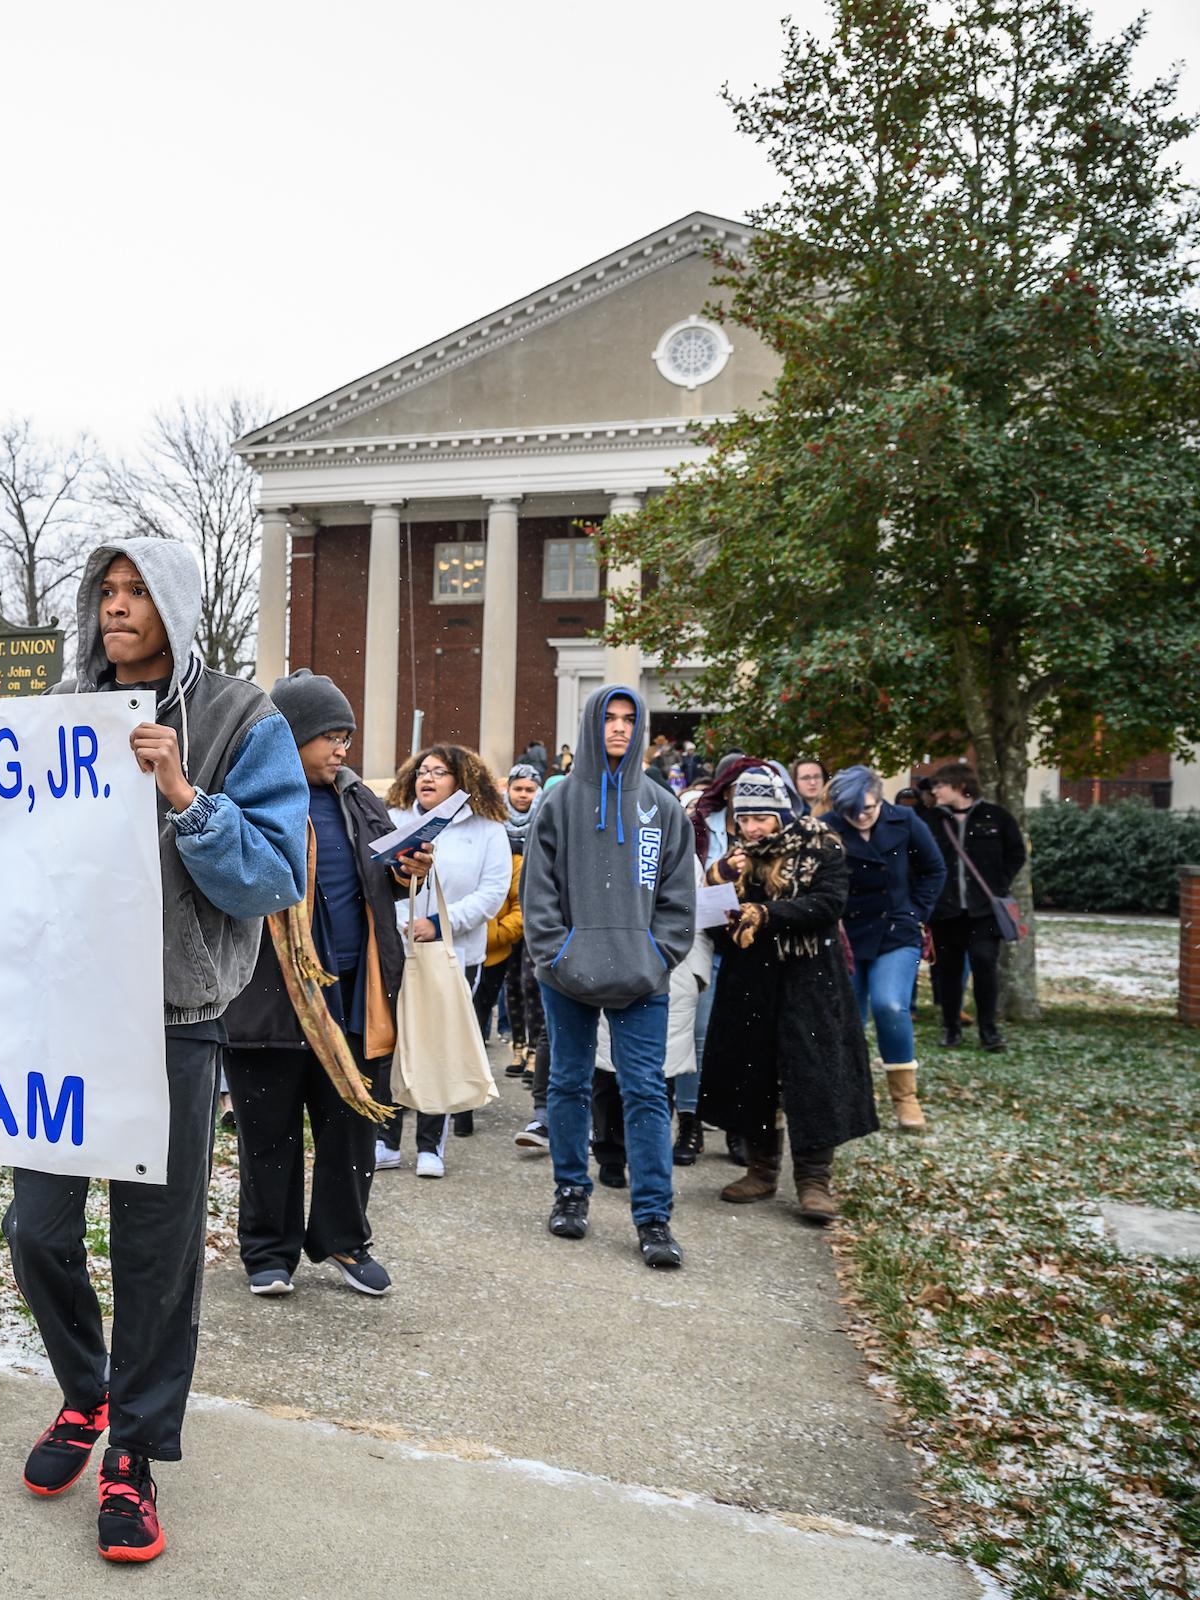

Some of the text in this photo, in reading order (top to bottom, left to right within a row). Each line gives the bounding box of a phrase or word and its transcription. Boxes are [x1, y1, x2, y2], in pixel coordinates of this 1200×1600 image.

[10, 639, 56, 656] UNION
[7, 666, 31, 678] John
[36, 664, 48, 677] G.
[7, 682, 20, 691] on
[30, 679, 47, 690] the
[47, 725, 111, 799] JR.
[639, 827, 661, 890] USAF
